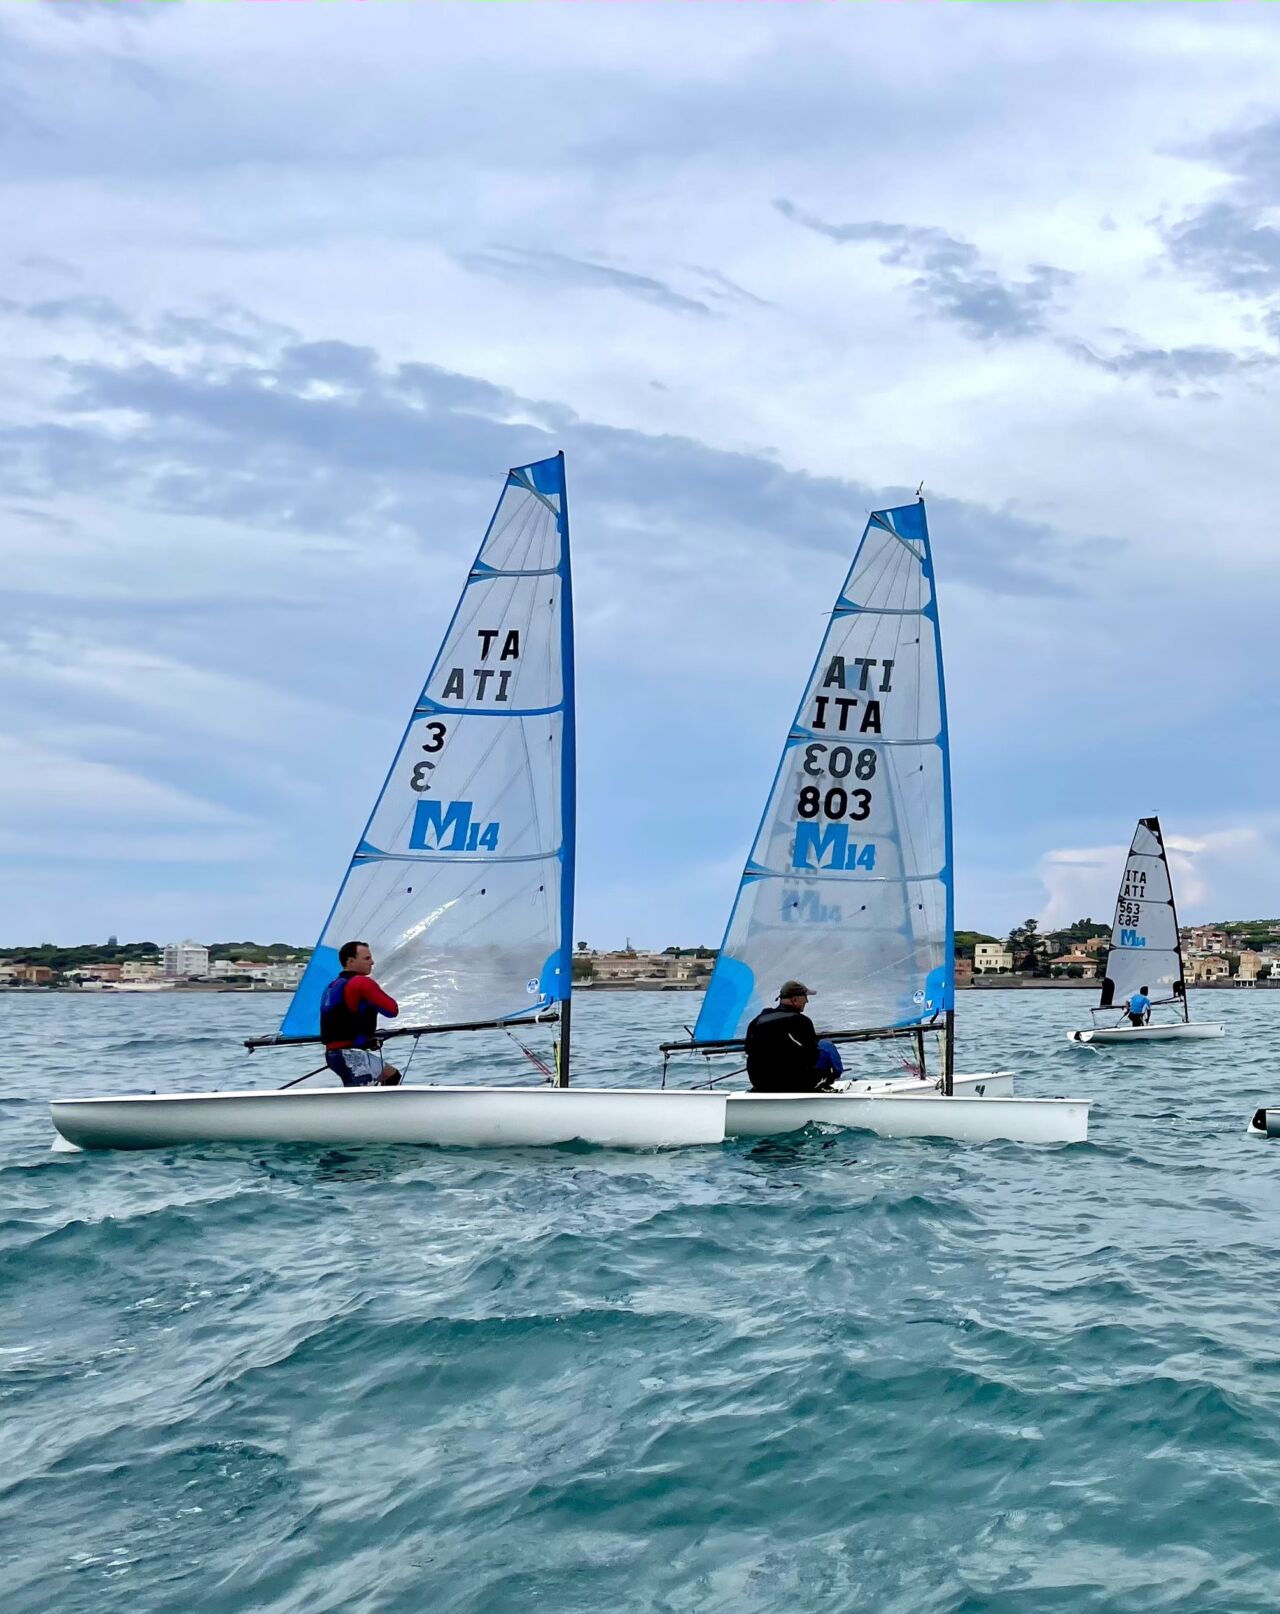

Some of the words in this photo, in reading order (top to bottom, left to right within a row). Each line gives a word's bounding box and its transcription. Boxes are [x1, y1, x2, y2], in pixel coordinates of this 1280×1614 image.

[478, 630, 519, 660] TA
[812, 696, 882, 733] ITA
[422, 722, 447, 752] 3
[797, 785, 872, 821] 803
[408, 799, 500, 852] M14
[792, 821, 876, 871] M14
[1126, 870, 1146, 884] ITA
[1120, 901, 1140, 914] 563
